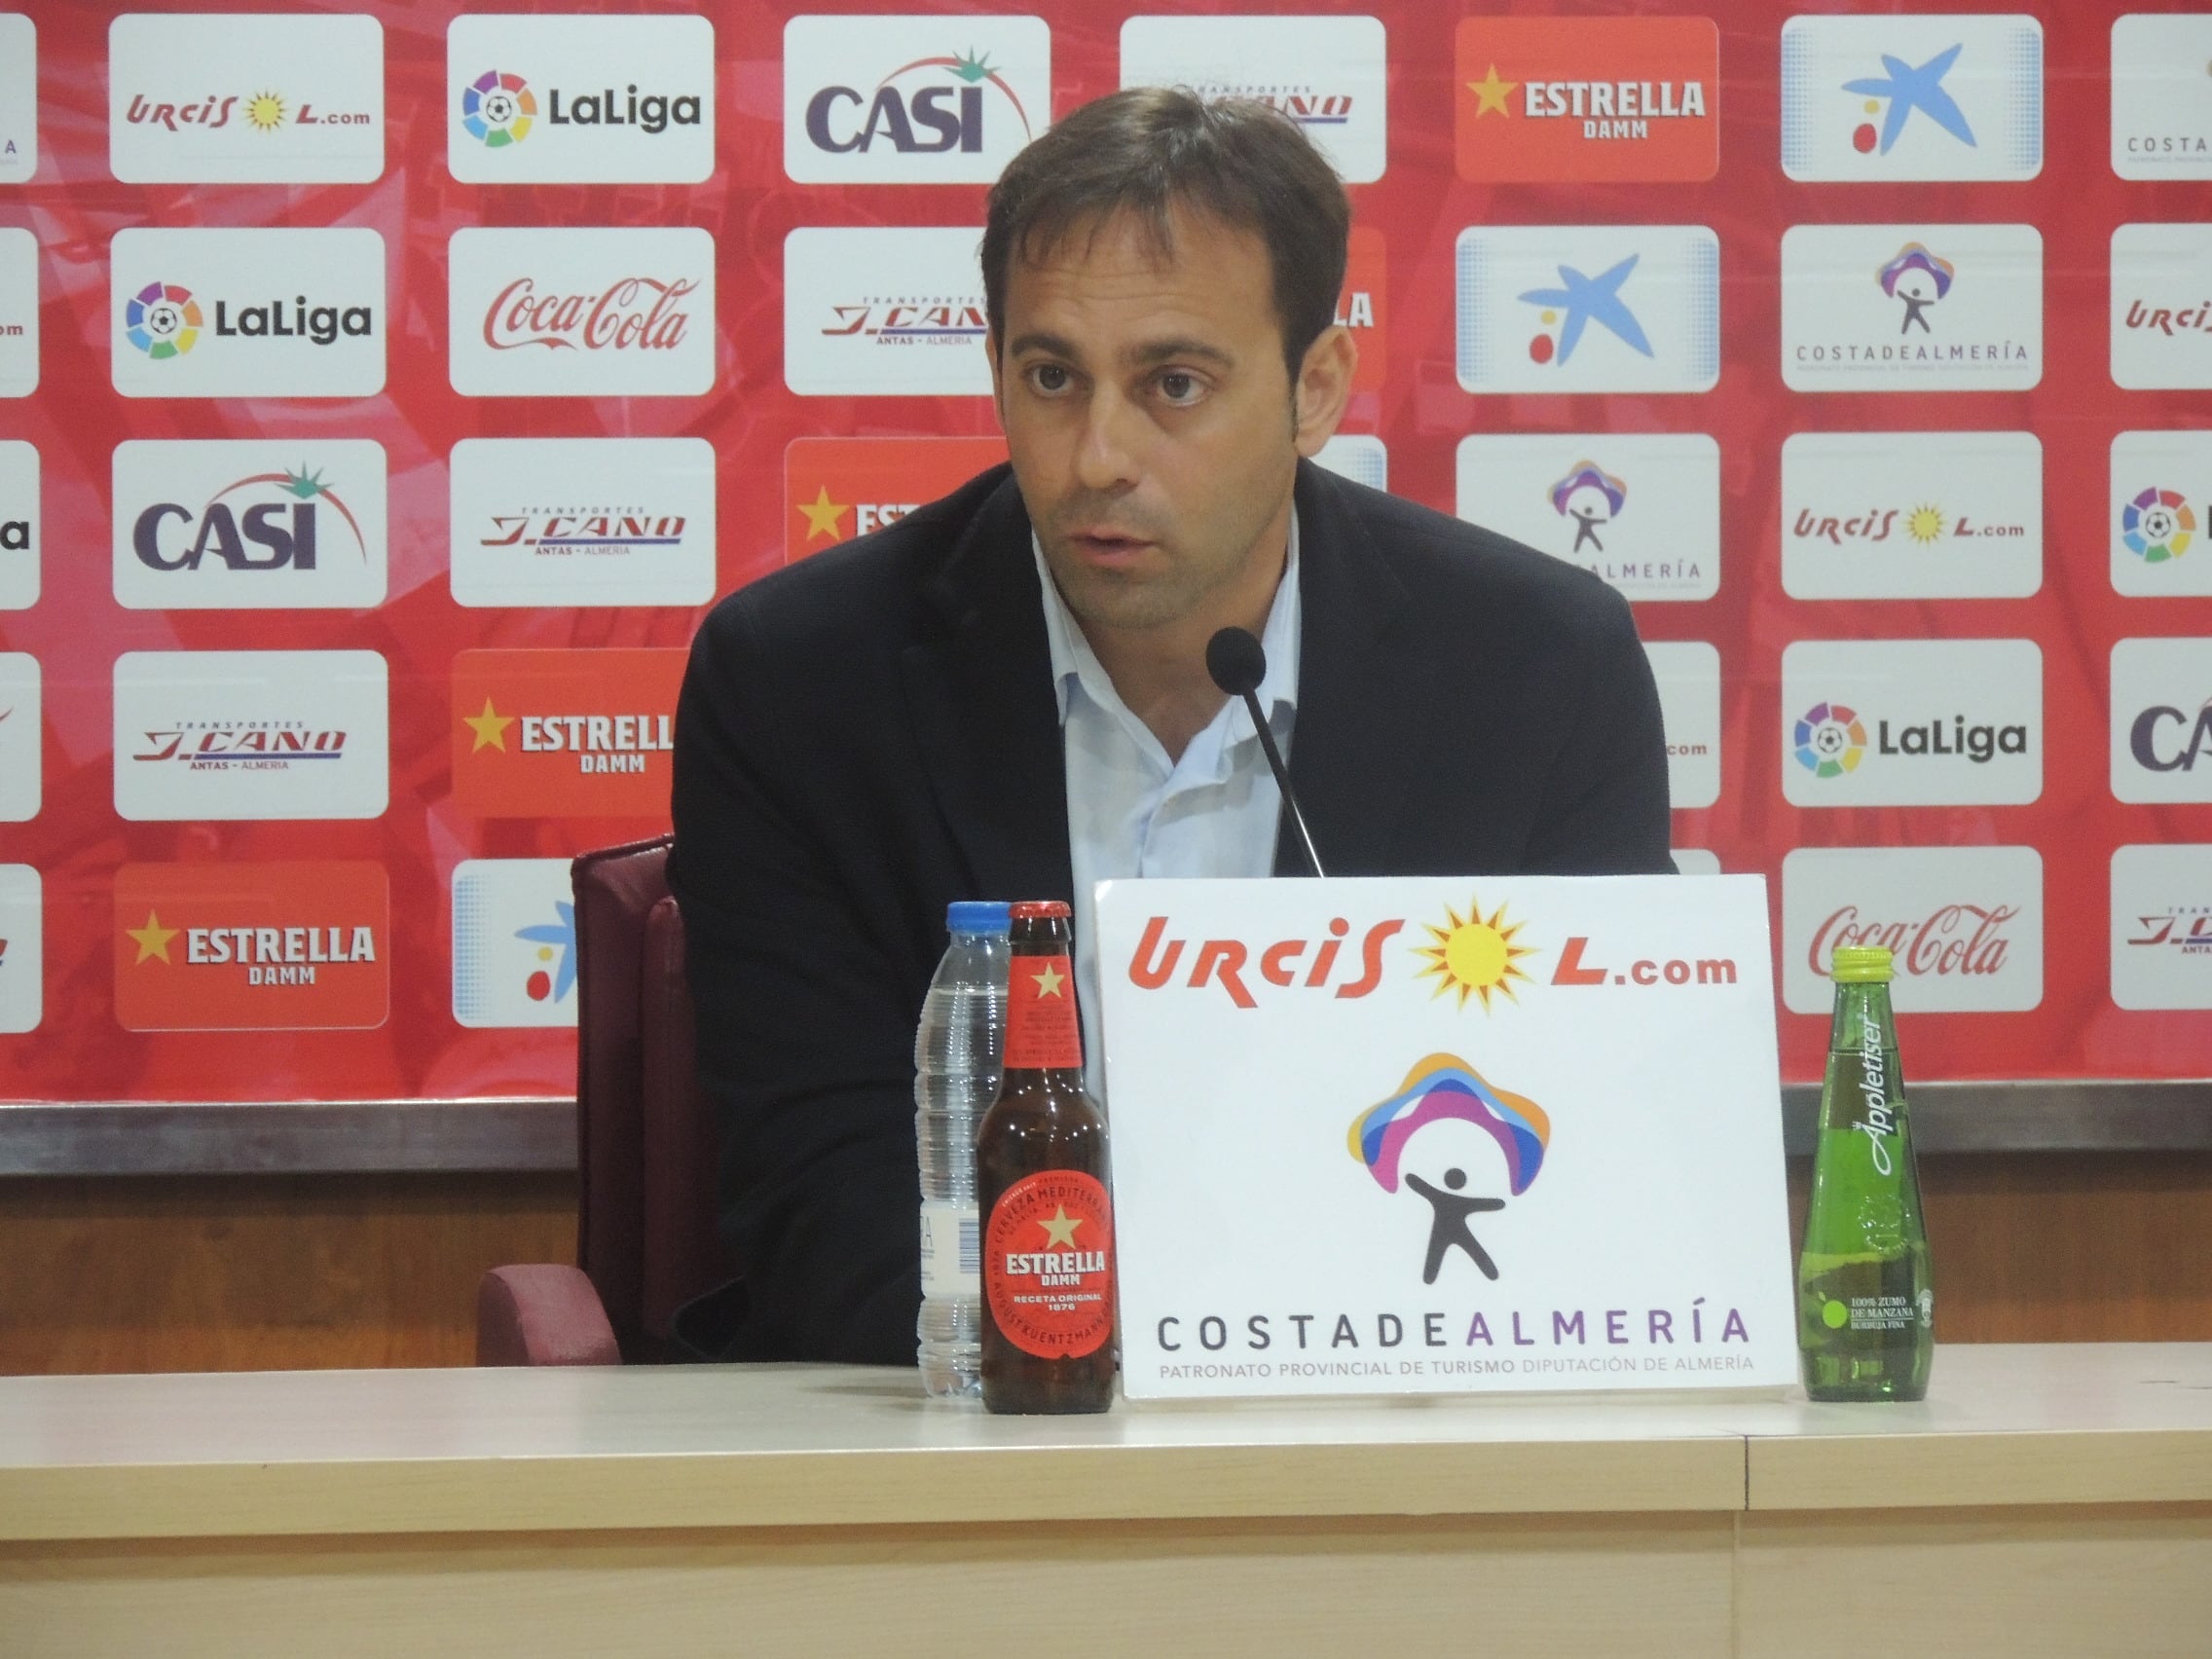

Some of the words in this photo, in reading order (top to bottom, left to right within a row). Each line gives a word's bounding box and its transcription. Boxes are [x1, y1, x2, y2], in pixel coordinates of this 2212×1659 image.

[550, 85, 701, 134] LaLiga
[1525, 81, 1706, 118] ESTRELLA
[805, 86, 983, 154] CASI
[1584, 120, 1648, 139] DAMM
[216, 296, 371, 346] LaLiga
[483, 277, 701, 350] Coca-Cola
[133, 502, 316, 570] CASI
[522, 716, 674, 752] ESTRELL
[1879, 716, 2026, 762] LaLiga
[190, 761, 229, 770] ANTAS
[580, 755, 645, 773] DAMM
[188, 927, 375, 965] ESTRELLA
[249, 966, 315, 985] DAMM
[1852, 1014, 1894, 1176] Appletiser
[1007, 1251, 1105, 1274] ESTRELLA
[1042, 1274, 1081, 1286] DAMM
[1058, 1293, 1101, 1303] ORIGINAL
[1852, 1309, 1865, 1317] DE
[1868, 1307, 1914, 1317] MANZANA
[1878, 1296, 1906, 1306] ZUMO
[1161, 1364, 1272, 1379] PATRONATO
[1279, 1362, 1392, 1376] PROVINCIAL
[1400, 1361, 1423, 1375] DE
[1432, 1359, 1514, 1374] TURISMO
[1523, 1355, 1637, 1373] DIPUTACIÓN
[1644, 1357, 1667, 1371] DE
[1675, 1354, 1754, 1371] ALMERÍA
